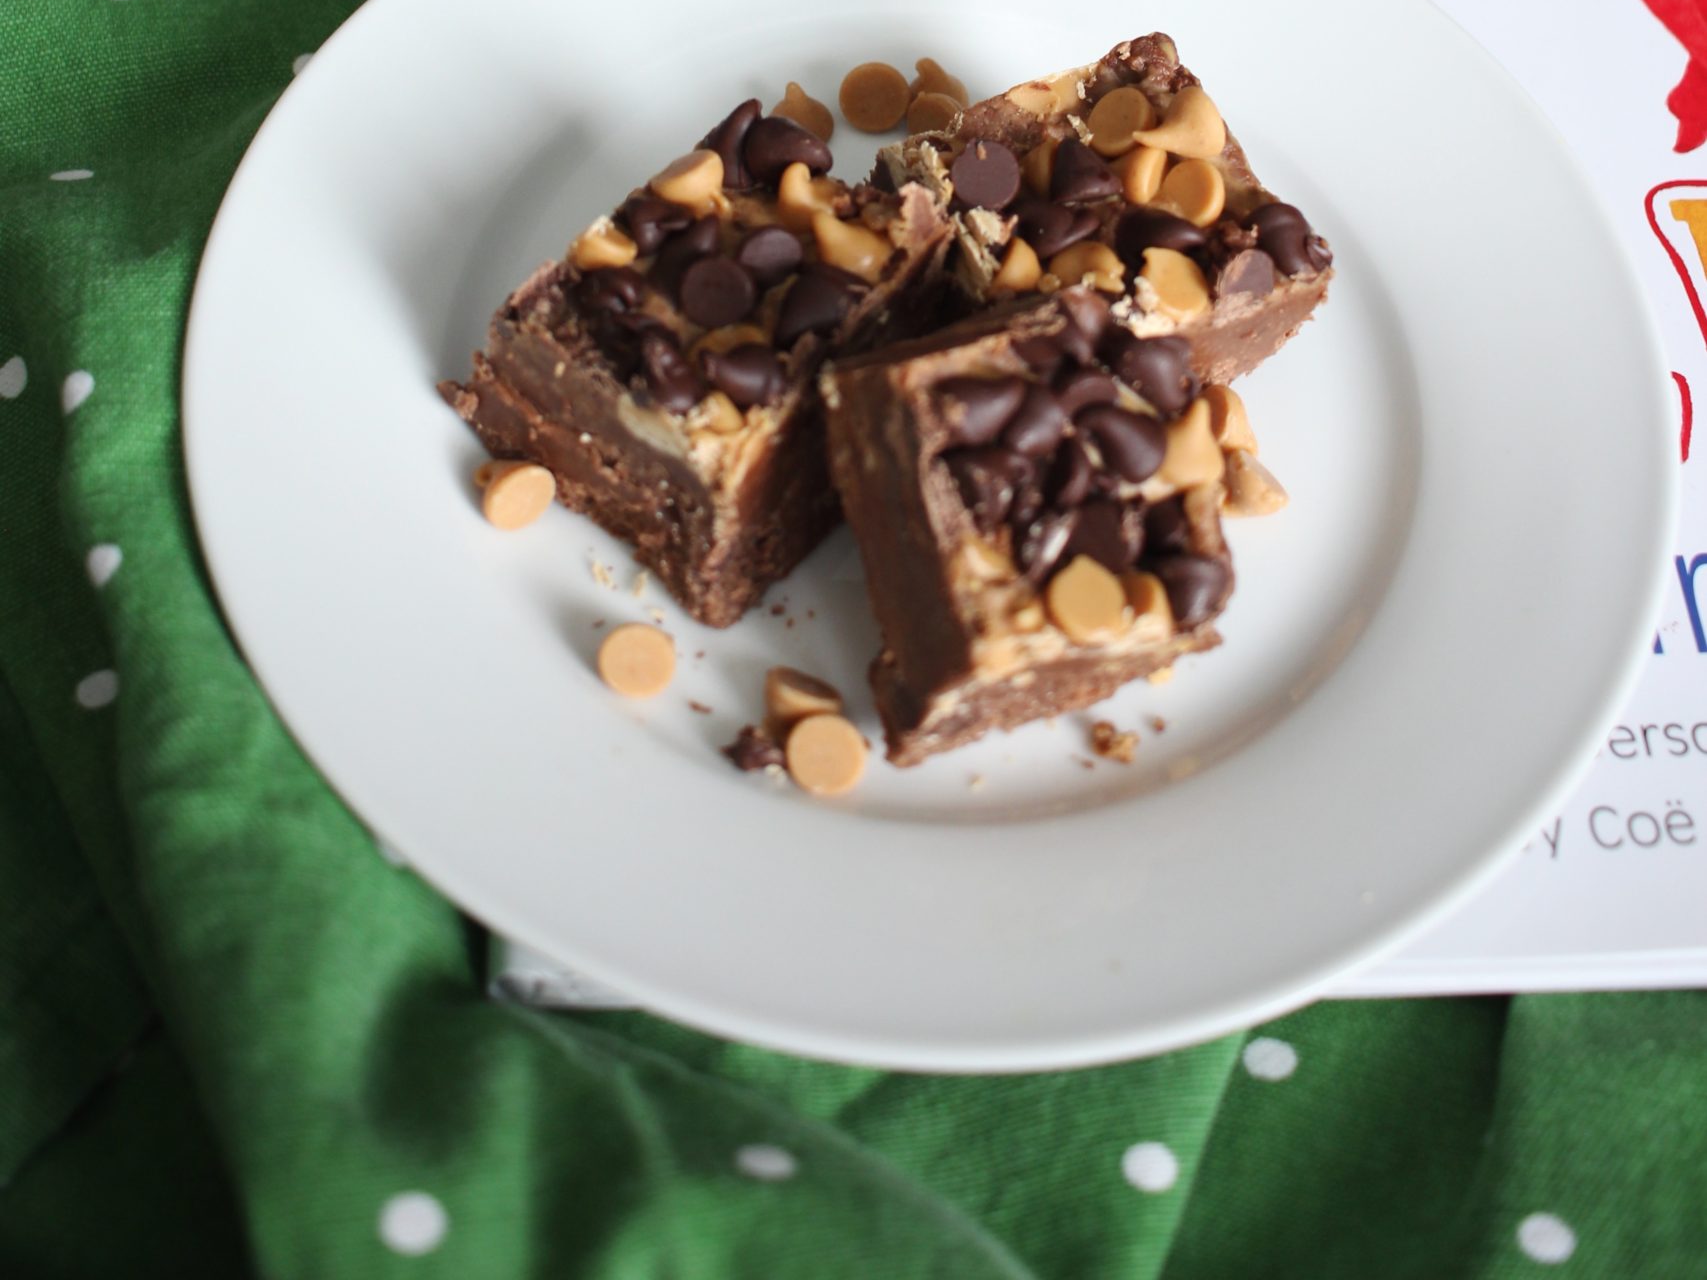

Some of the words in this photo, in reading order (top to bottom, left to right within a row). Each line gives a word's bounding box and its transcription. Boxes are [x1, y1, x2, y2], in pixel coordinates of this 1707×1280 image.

[1605, 722, 1707, 759] erso
[1540, 817, 1562, 858] y
[1588, 800, 1697, 850] Coë
